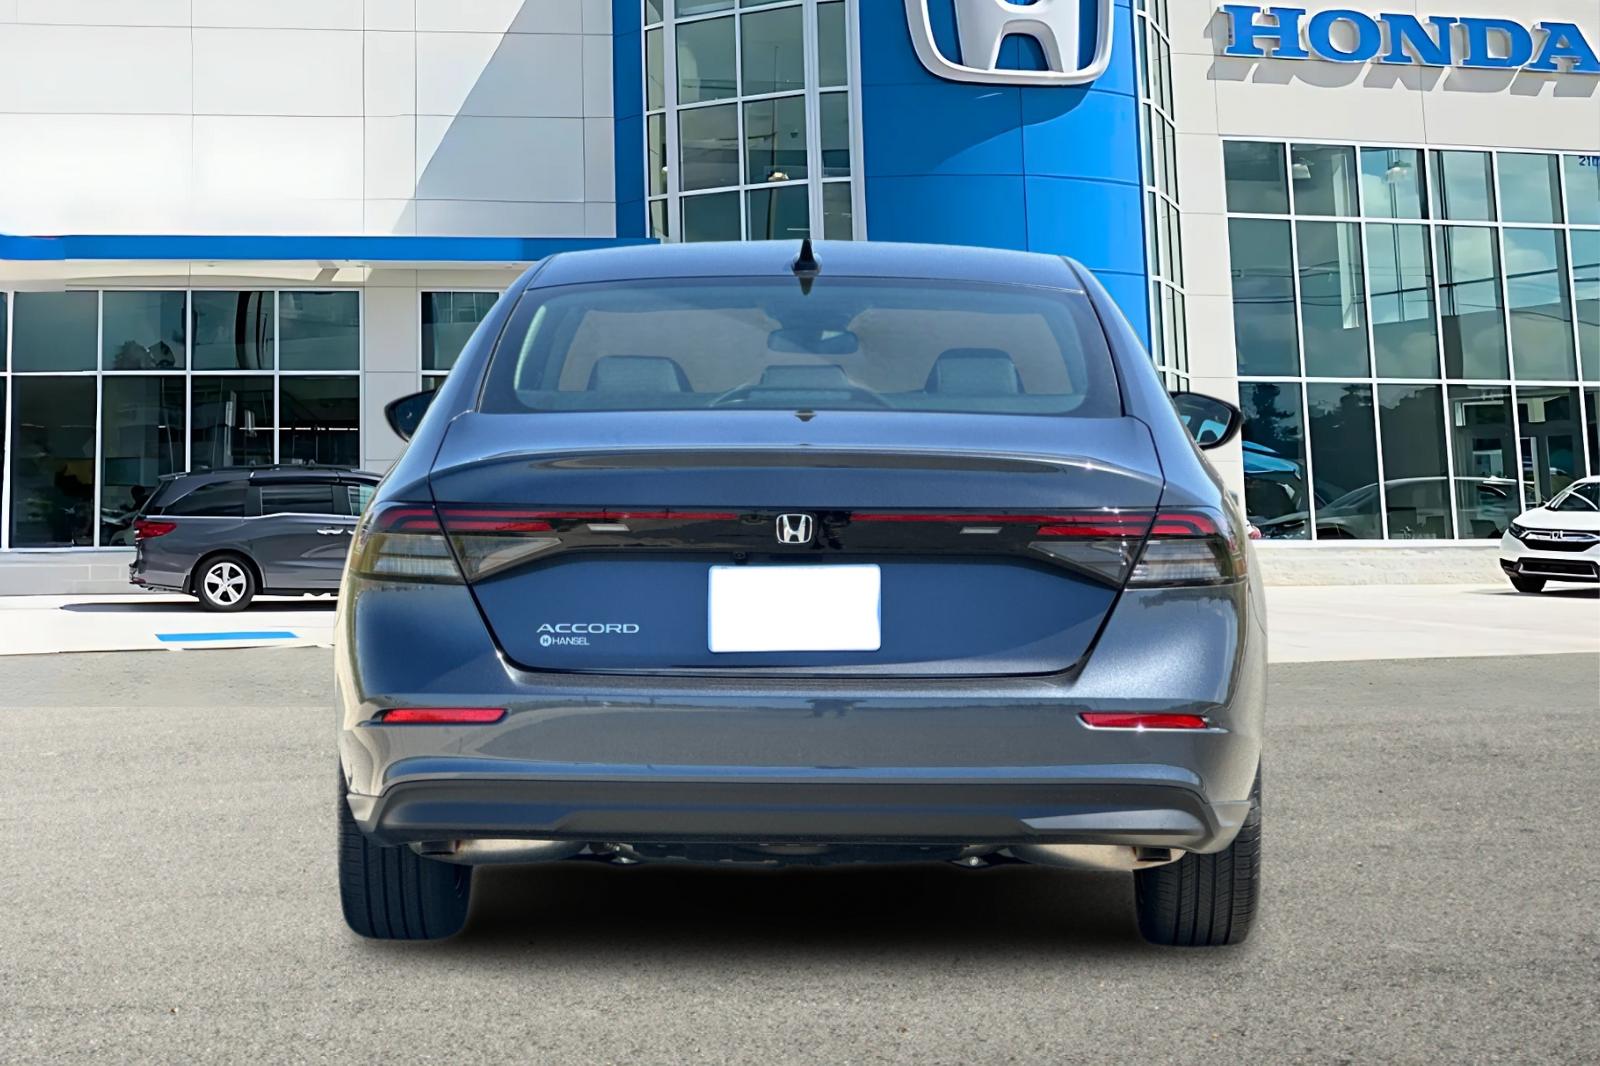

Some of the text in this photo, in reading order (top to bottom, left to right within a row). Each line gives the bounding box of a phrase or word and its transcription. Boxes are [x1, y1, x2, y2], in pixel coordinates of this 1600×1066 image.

[1223, 5, 1600, 72] HONDA
[536, 623, 640, 633] ACCORD
[552, 636, 590, 646] HANSEL
